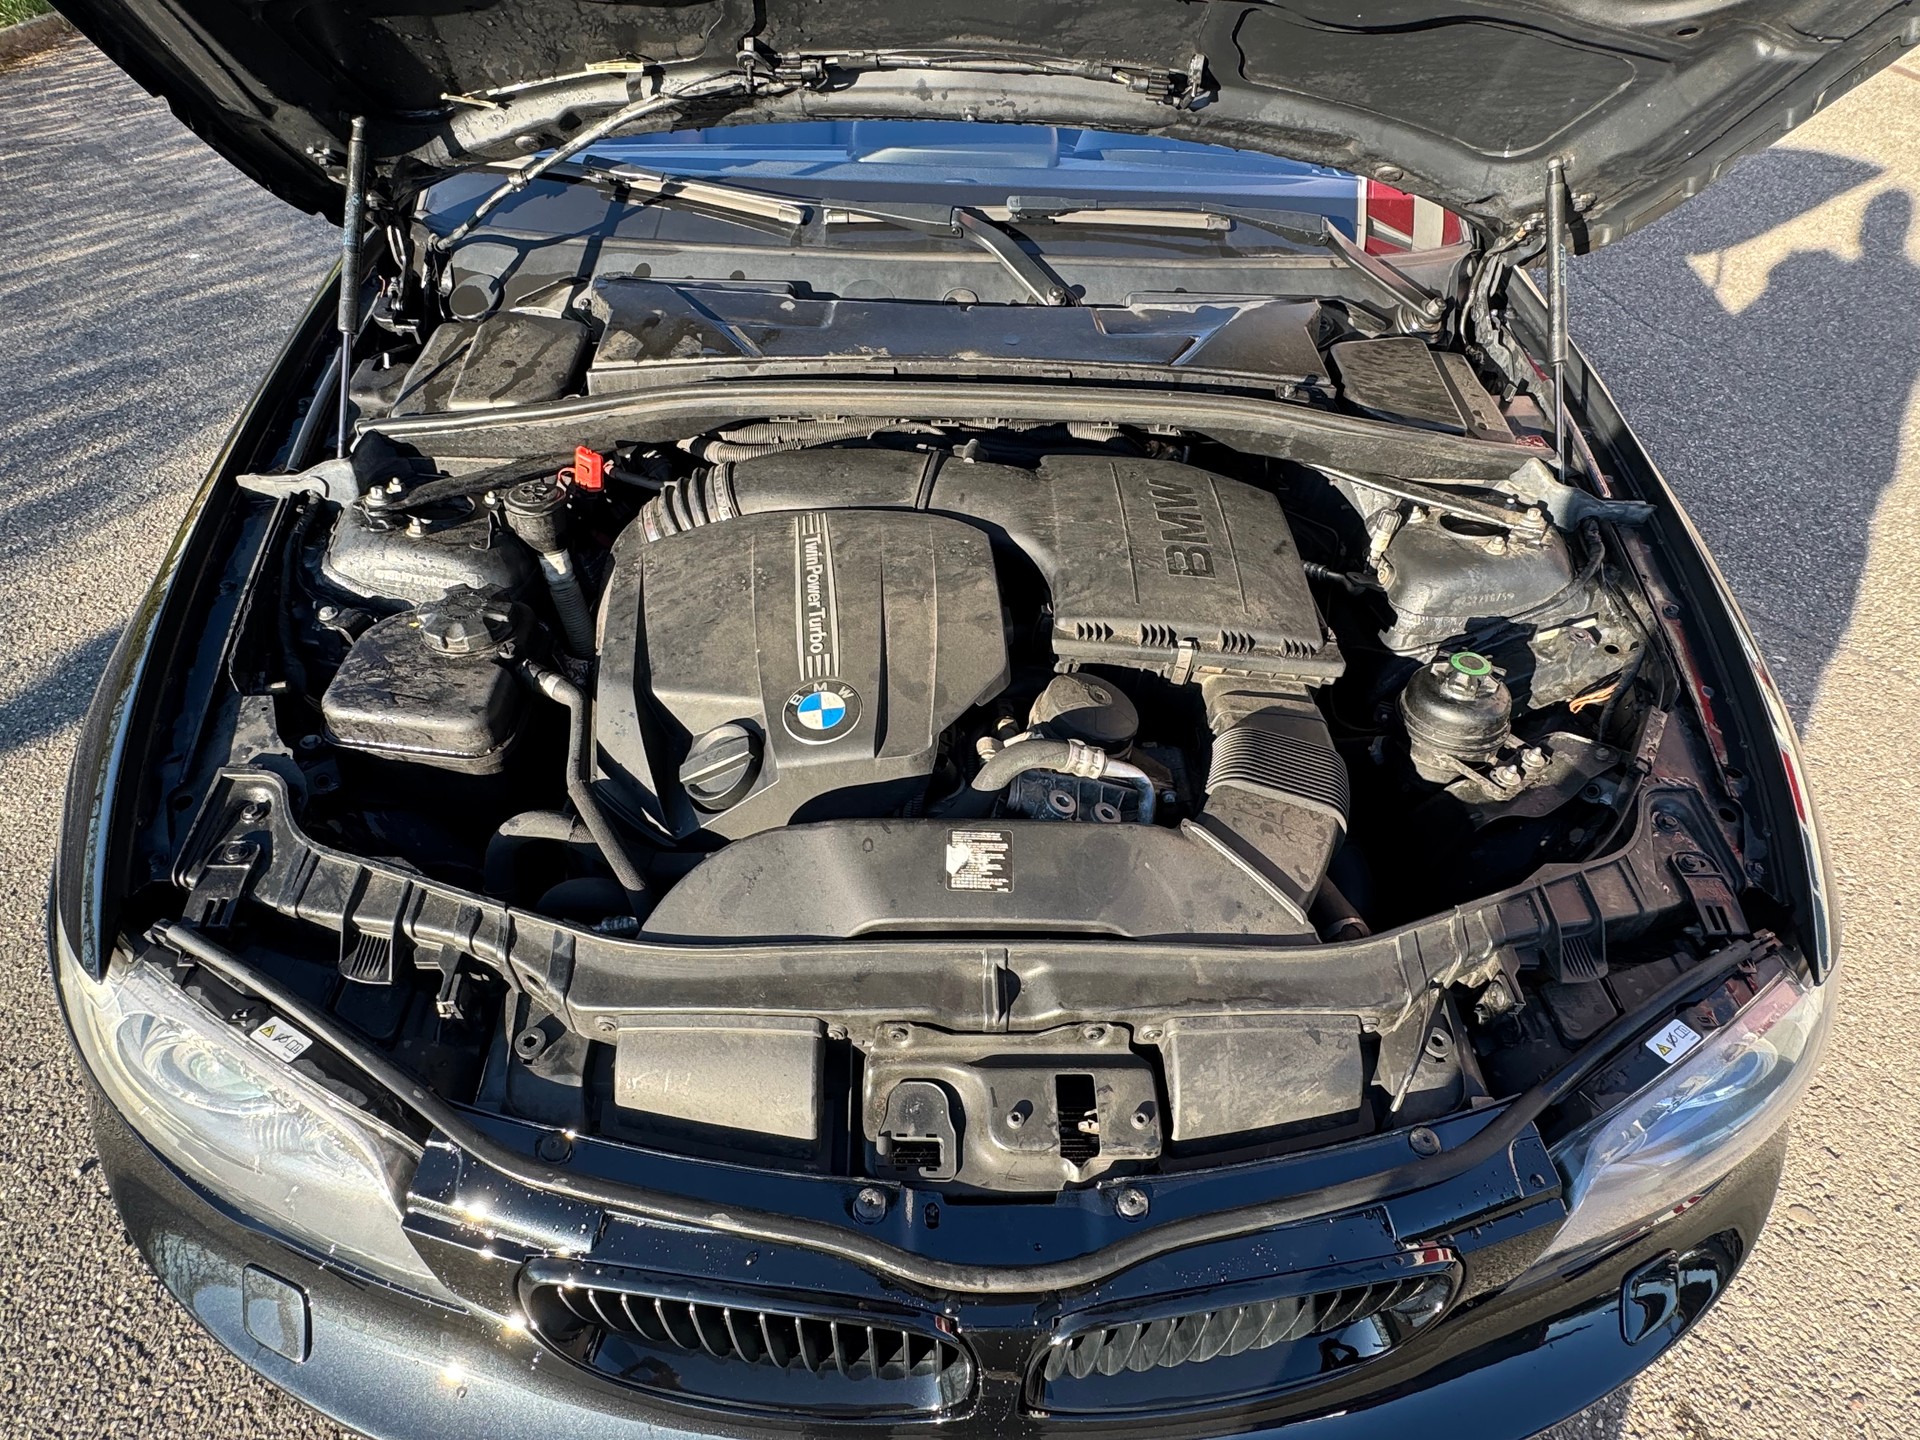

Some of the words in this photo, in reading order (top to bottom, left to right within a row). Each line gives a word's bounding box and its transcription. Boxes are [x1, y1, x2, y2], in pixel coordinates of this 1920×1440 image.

[1147, 478, 1216, 579] BMW
[804, 533, 824, 609] TwinPower
[809, 607, 827, 654] Turbo
[789, 682, 853, 706] BMW
